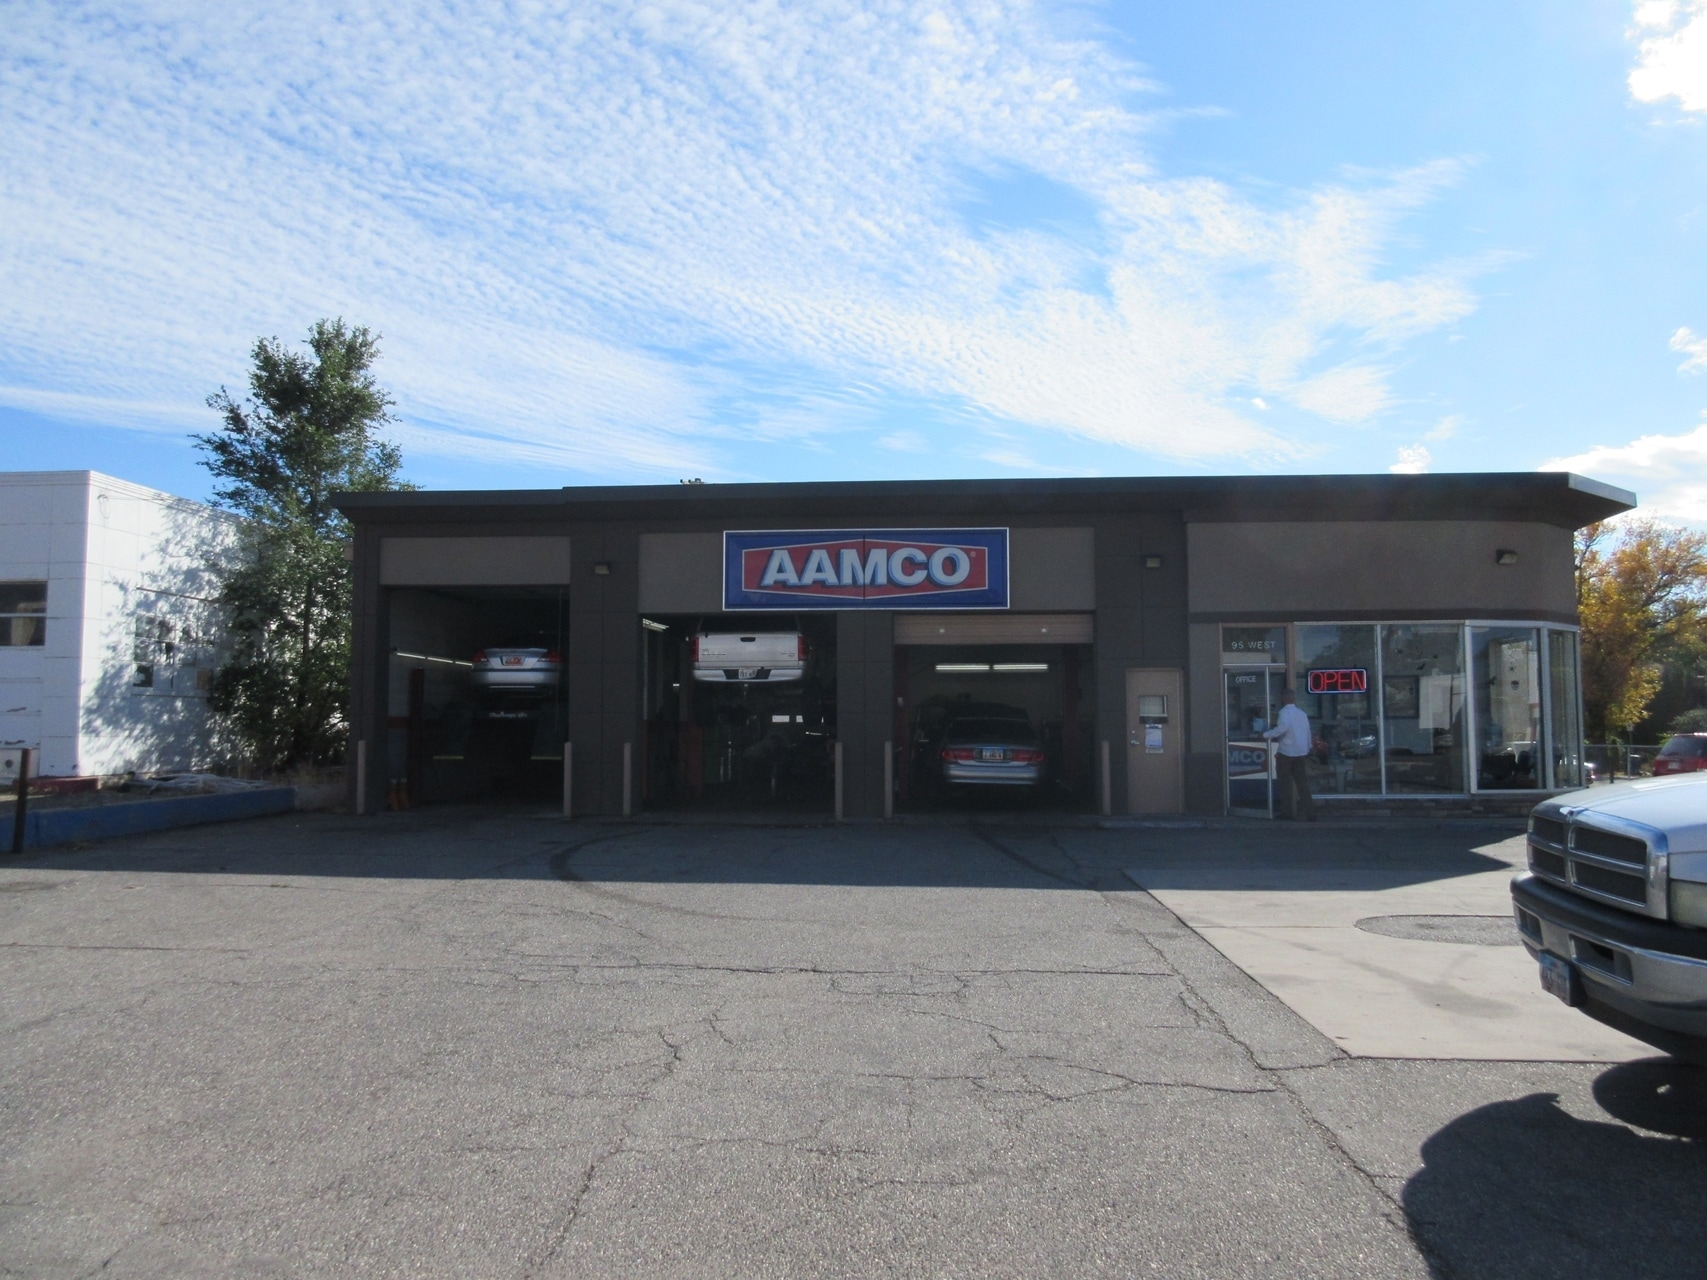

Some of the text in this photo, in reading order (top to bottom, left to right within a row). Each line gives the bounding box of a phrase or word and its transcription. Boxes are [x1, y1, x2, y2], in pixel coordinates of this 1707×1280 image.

[760, 547, 971, 586] AAMCO
[1231, 641, 1276, 650] 95 WEST
[1235, 675, 1256, 683] OFFICE
[1310, 671, 1366, 692] OPEN
